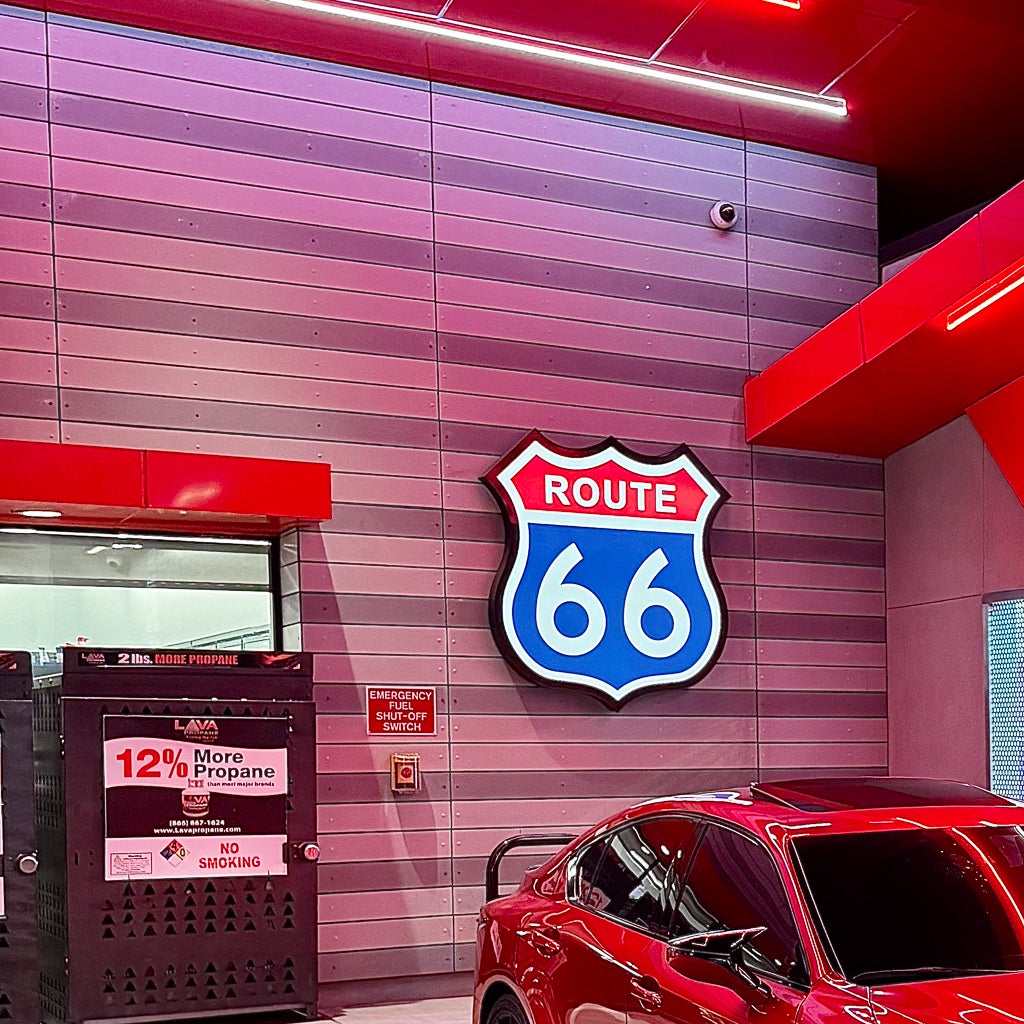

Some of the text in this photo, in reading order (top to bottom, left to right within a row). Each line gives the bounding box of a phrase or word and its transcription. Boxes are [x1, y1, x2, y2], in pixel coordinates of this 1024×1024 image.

[543, 474, 678, 514] ROUTE
[535, 542, 692, 659] 66
[117, 653, 239, 665] 2 lbs. MORE PROPANE
[369, 690, 432, 701] EMERGENCY
[389, 701, 414, 710] FUEL
[376, 711, 427, 721] SHUT-OFF
[174, 719, 219, 731] LAVA
[382, 722, 421, 731] SWITCH
[116, 748, 243, 779] 12% More
[194, 764, 275, 781] Propane
[220, 843, 239, 854] NO
[199, 857, 261, 869] SMOKING
